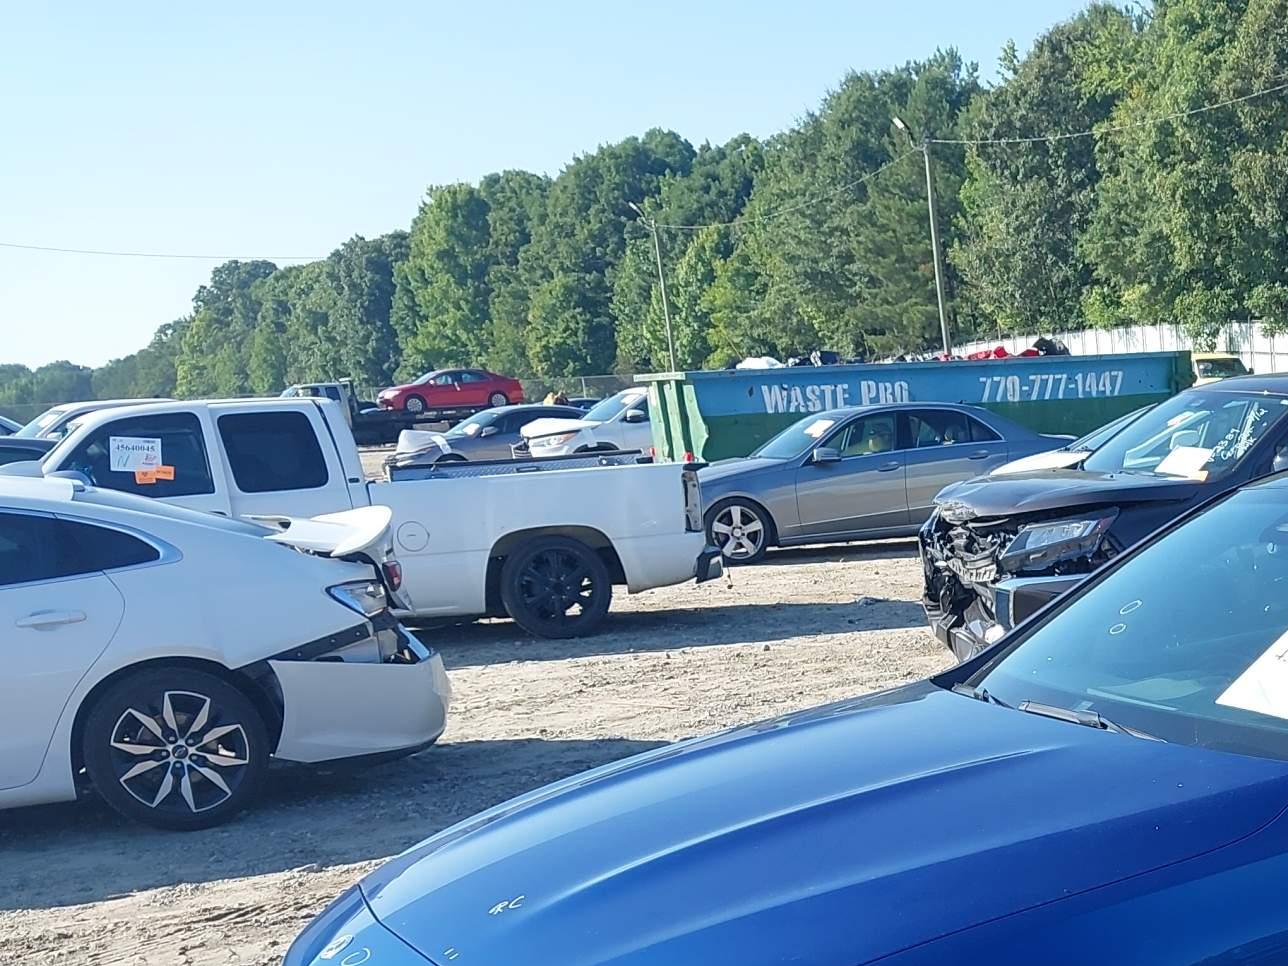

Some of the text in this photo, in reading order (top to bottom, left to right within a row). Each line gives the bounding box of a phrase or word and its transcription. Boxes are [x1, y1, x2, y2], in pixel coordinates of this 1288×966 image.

[761, 371, 1123, 413] WASTE PRO 770-777-1447
